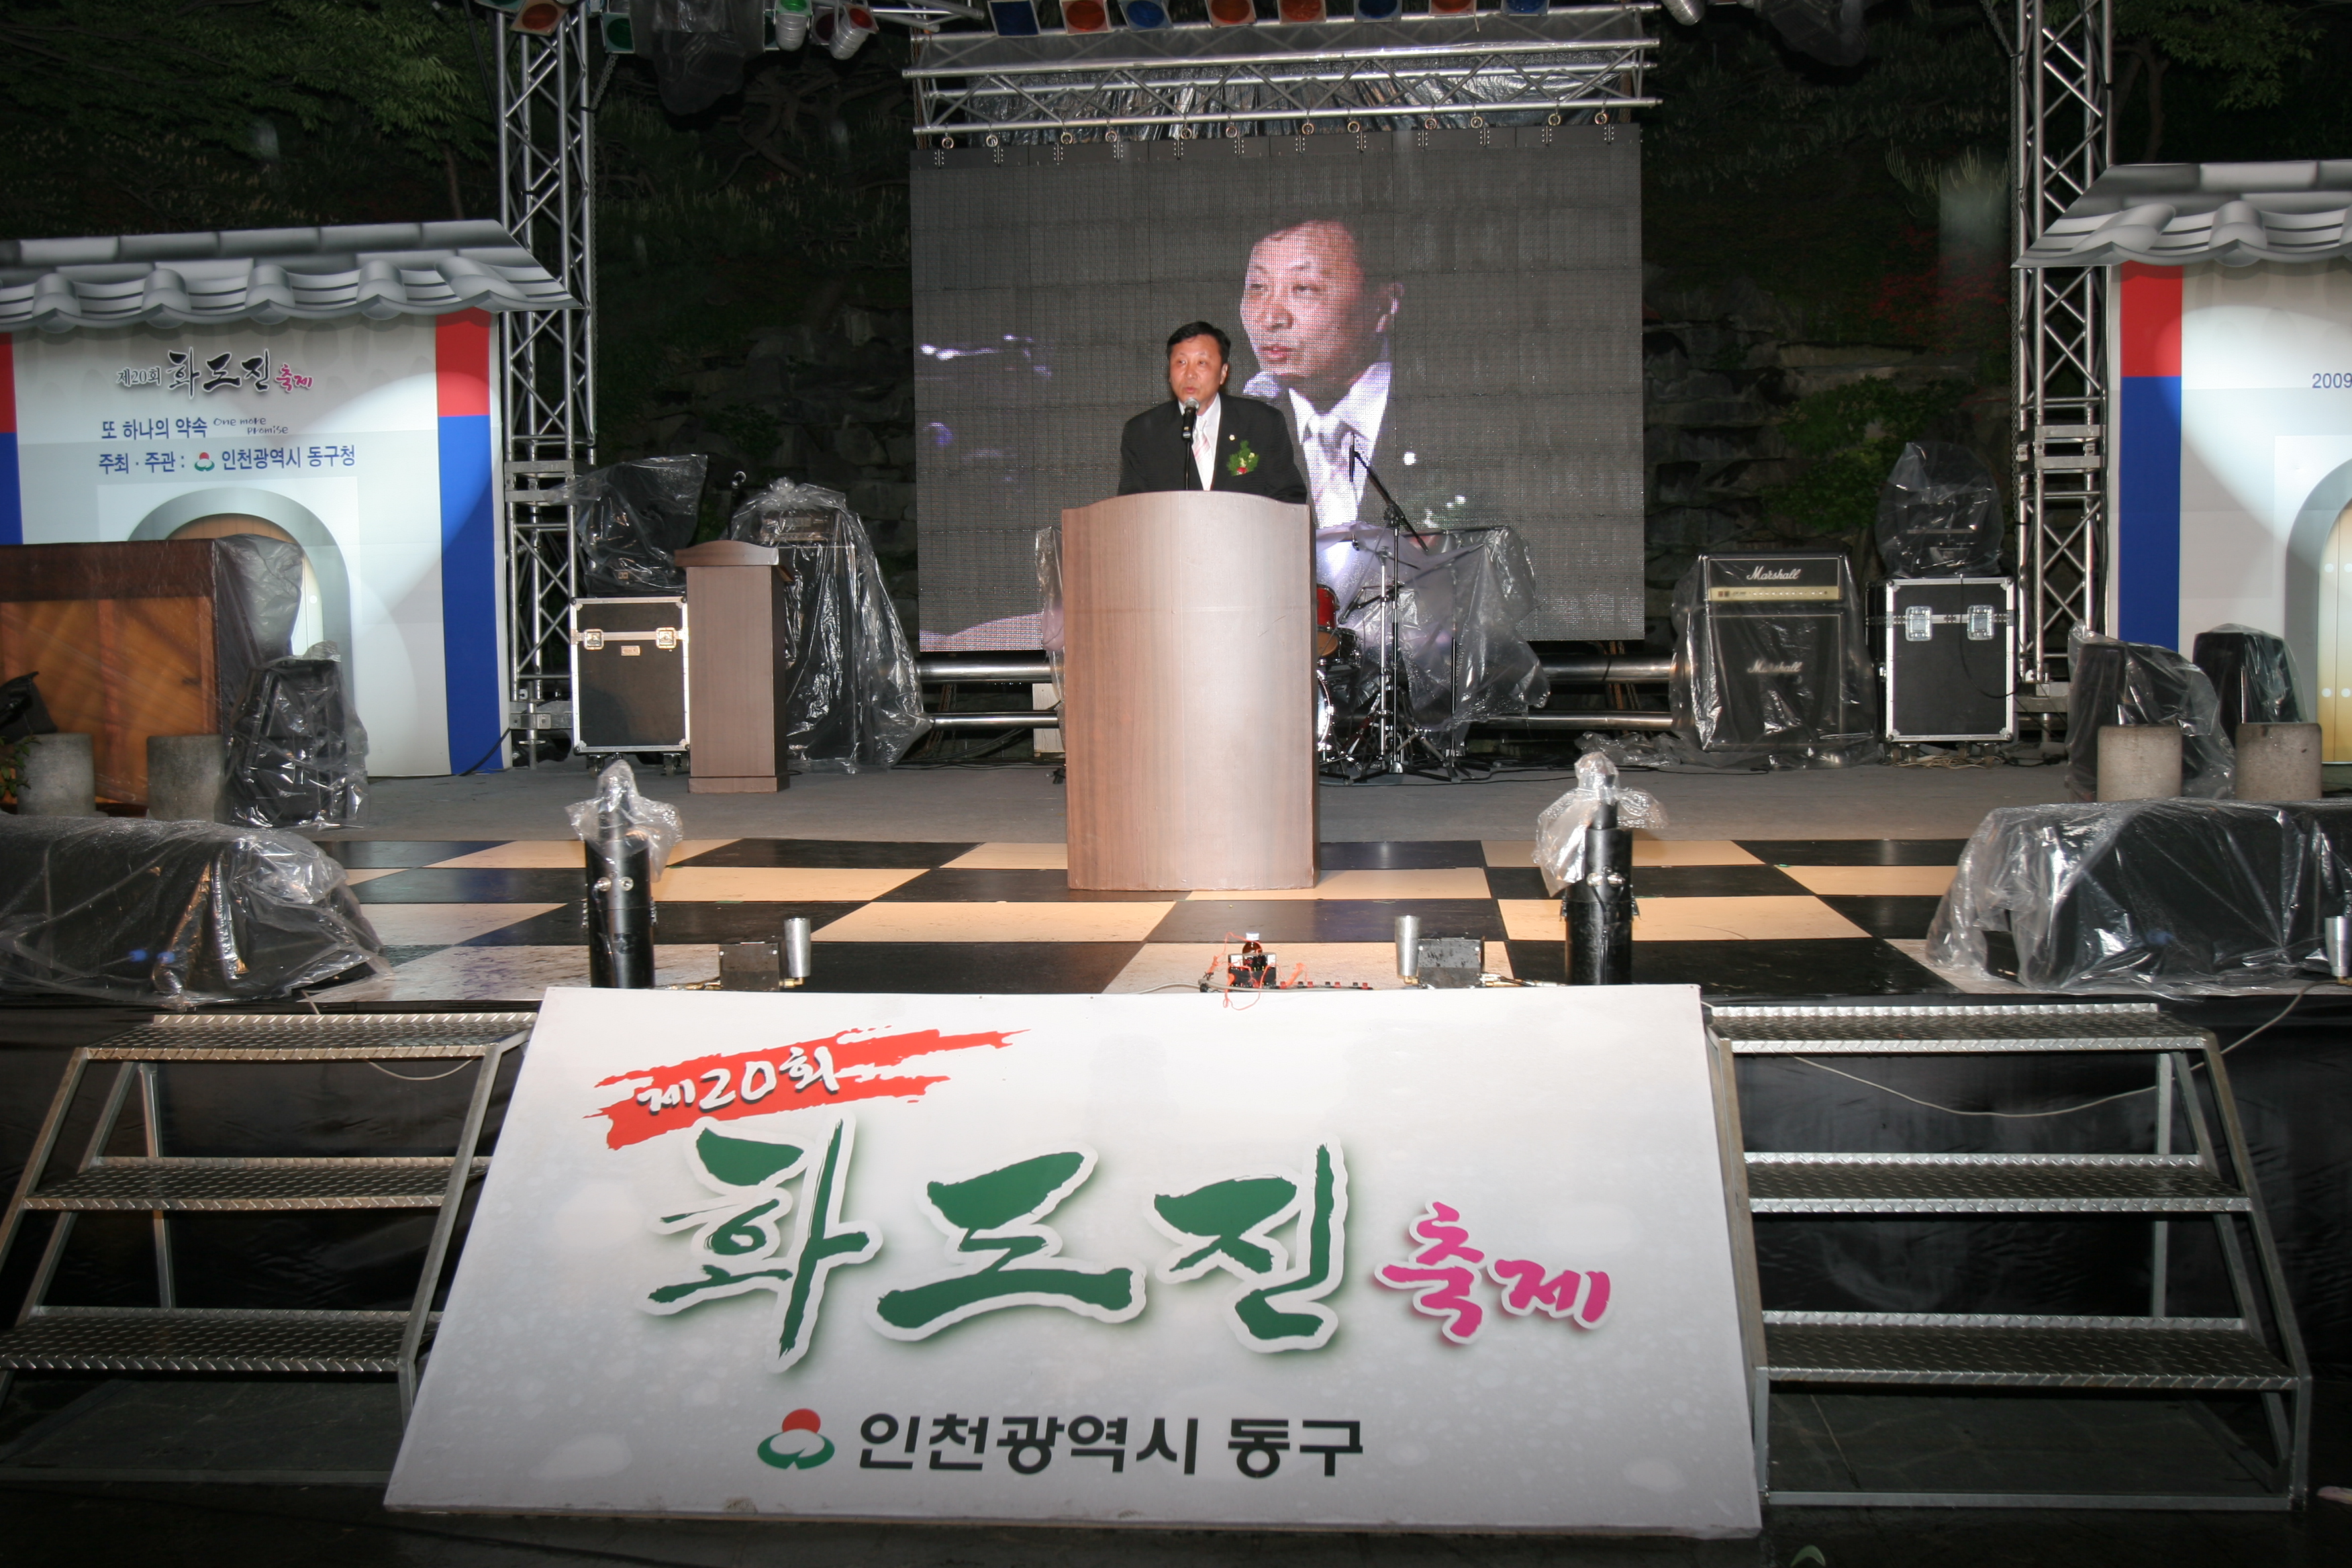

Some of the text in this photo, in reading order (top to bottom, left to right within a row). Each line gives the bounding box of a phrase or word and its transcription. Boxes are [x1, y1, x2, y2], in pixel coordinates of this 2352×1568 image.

[117, 346, 313, 399] 제20회 화도진 축제
[2312, 373, 2352, 389] 2009
[101, 417, 207, 440] 또 하나의 약속
[213, 417, 266, 426] One more
[99, 453, 129, 474] 주최
[222, 446, 301, 471] 인천광역시
[307, 444, 356, 468] 동구청
[1746, 566, 1802, 581] Marshall
[638, 1046, 840, 1113] 제20회
[648, 1118, 1610, 1359] 화도진 축제
[859, 1412, 1363, 1479] 인천광역시 동구
